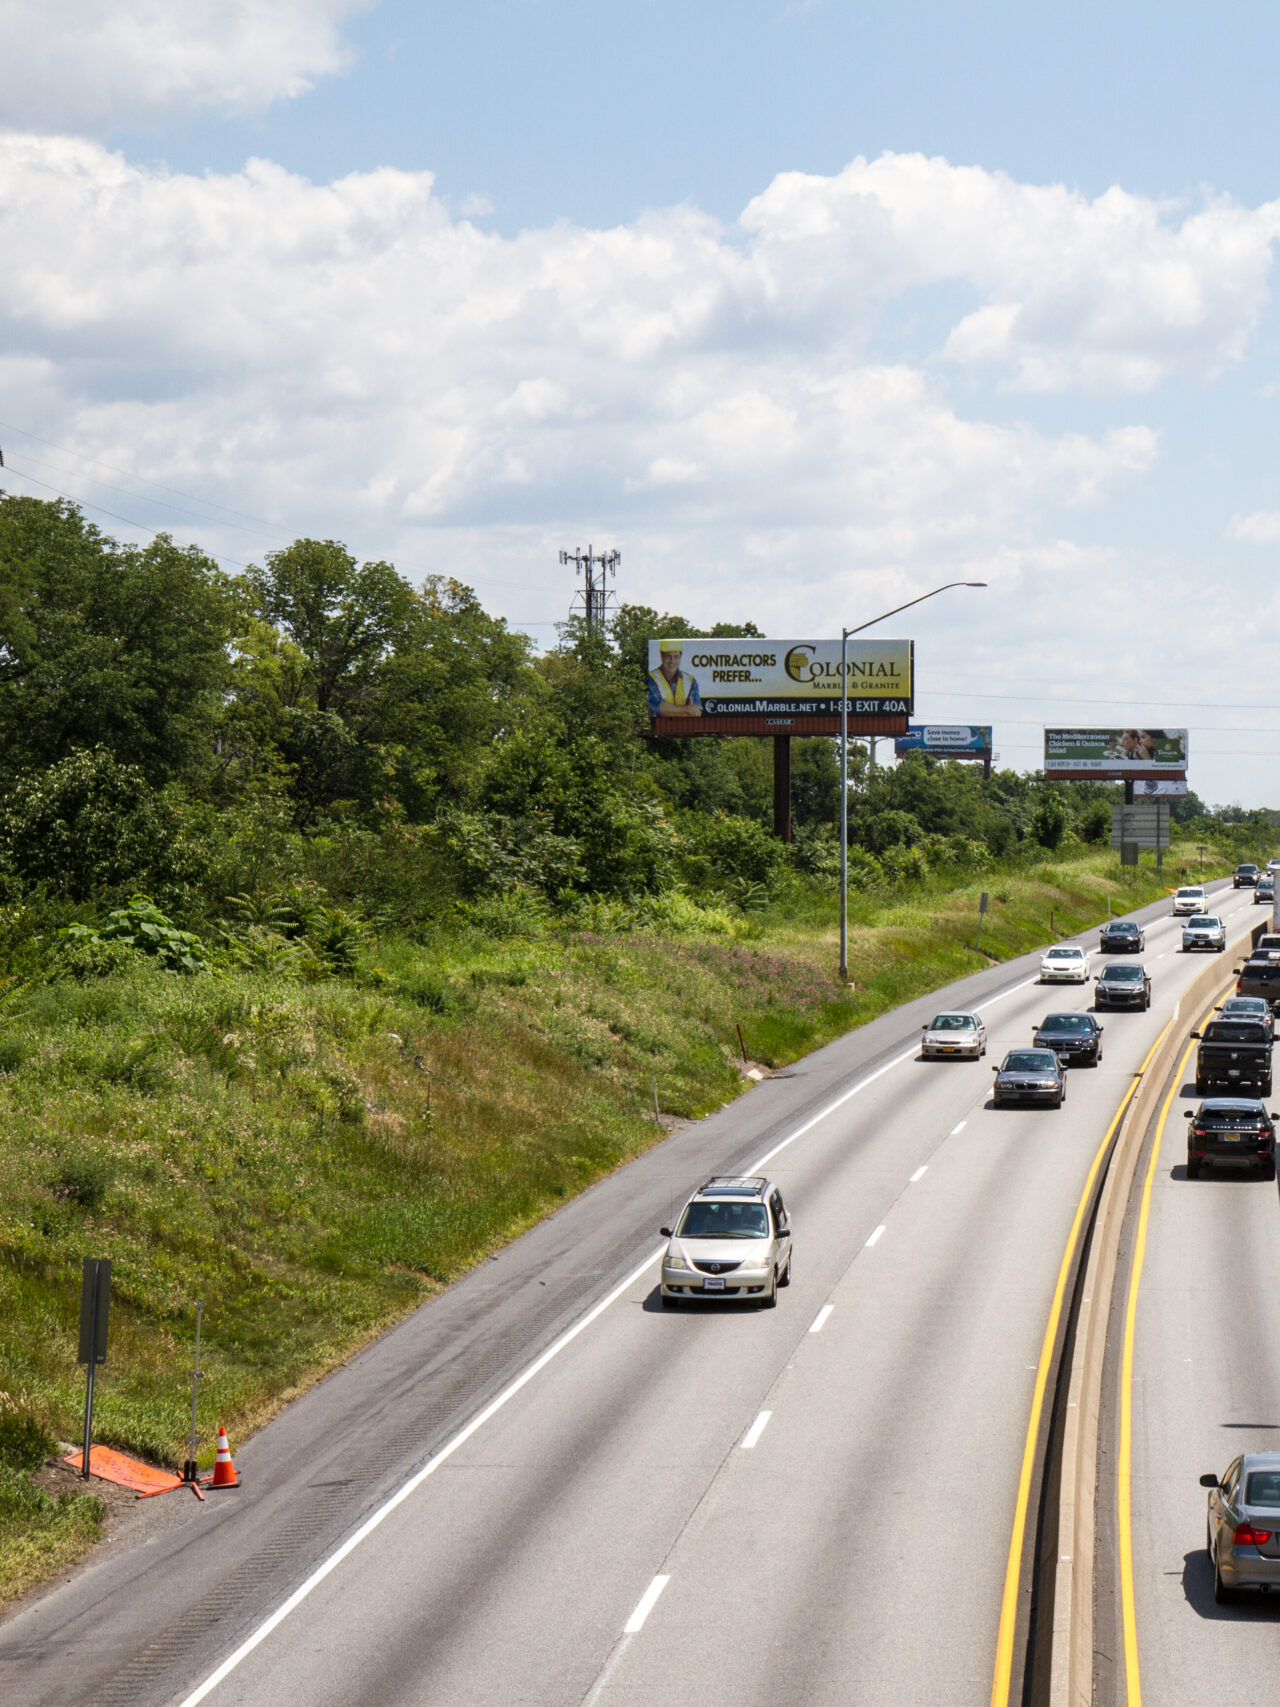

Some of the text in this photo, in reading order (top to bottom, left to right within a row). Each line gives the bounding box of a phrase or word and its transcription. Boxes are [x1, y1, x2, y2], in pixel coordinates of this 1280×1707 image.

[691, 653, 777, 668] CONTRACTORS
[784, 644, 901, 683] COLONIAL
[712, 669, 762, 683] PREFER...
[813, 681, 900, 689] MARBL & GRANITE
[830, 700, 853, 712] I-83
[856, 700, 879, 712] EXIT
[882, 700, 907, 713] 40A
